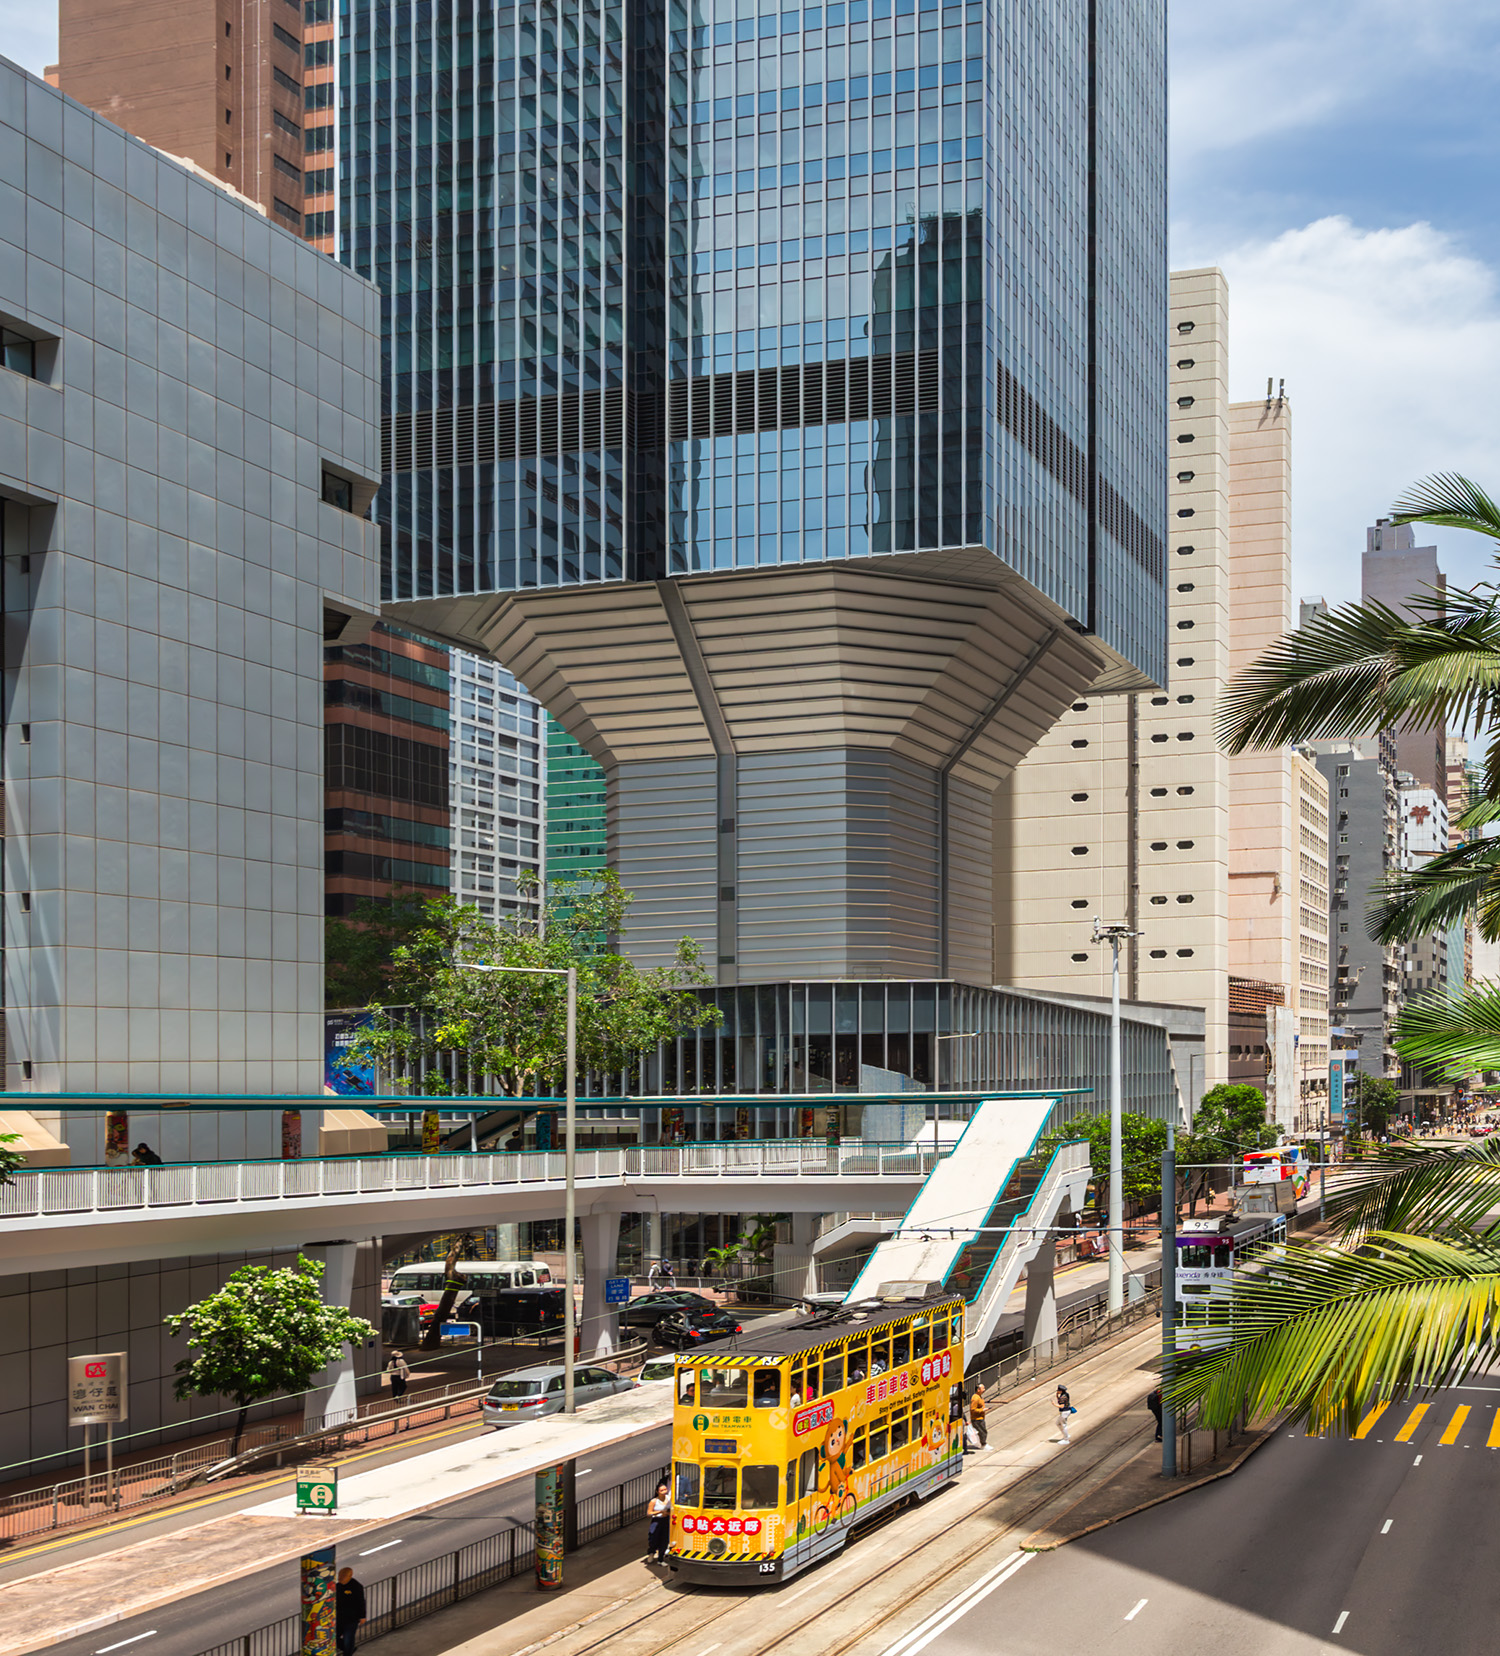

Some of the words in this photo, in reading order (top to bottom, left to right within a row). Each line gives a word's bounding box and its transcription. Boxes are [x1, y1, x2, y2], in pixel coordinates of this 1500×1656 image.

[1194, 1221, 1210, 1230] 95
[761, 1356, 781, 1365] 135
[866, 1370, 908, 1405] 車前車後
[922, 1354, 950, 1383] 有盲點
[879, 1406, 889, 1414] Stay
[889, 1401, 897, 1409] Off
[713, 1415, 752, 1423] 香港電車
[683, 1518, 759, 1532] 咪貼太近呀
[759, 1562, 775, 1573] 135
